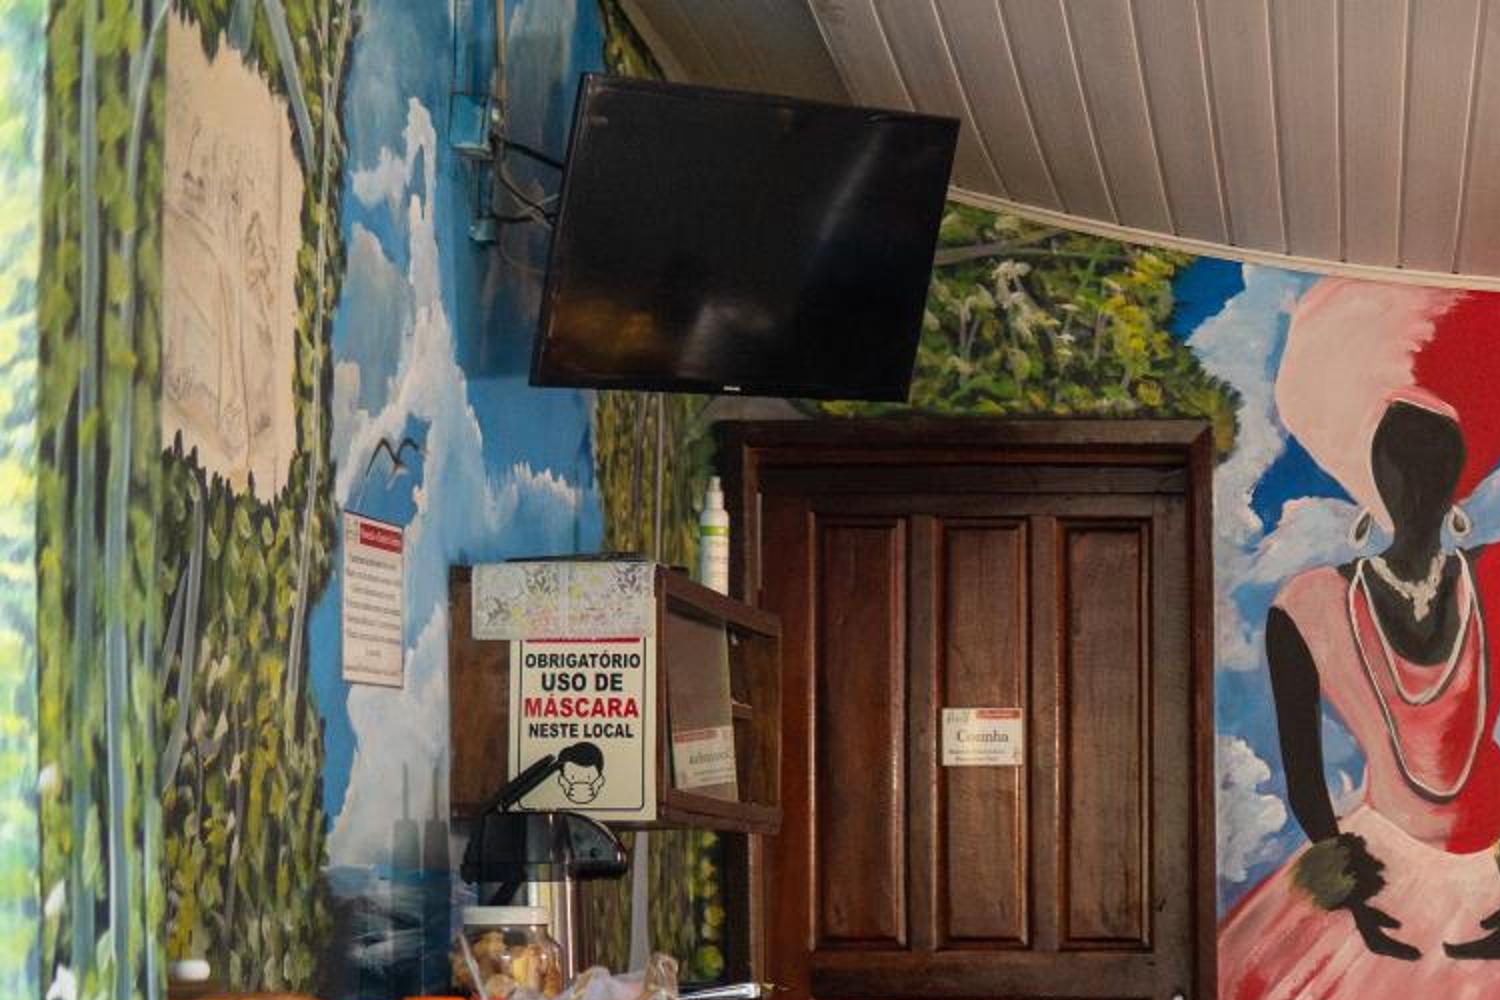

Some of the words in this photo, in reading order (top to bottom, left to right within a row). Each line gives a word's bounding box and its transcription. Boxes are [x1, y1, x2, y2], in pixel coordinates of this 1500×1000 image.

[525, 650, 640, 669] OBRIGATÓRIO
[541, 673, 587, 691] USO
[595, 673, 623, 691] DE
[525, 694, 639, 718] MÁSCARA
[529, 723, 579, 738] NESTE
[583, 723, 634, 738] LOCAL
